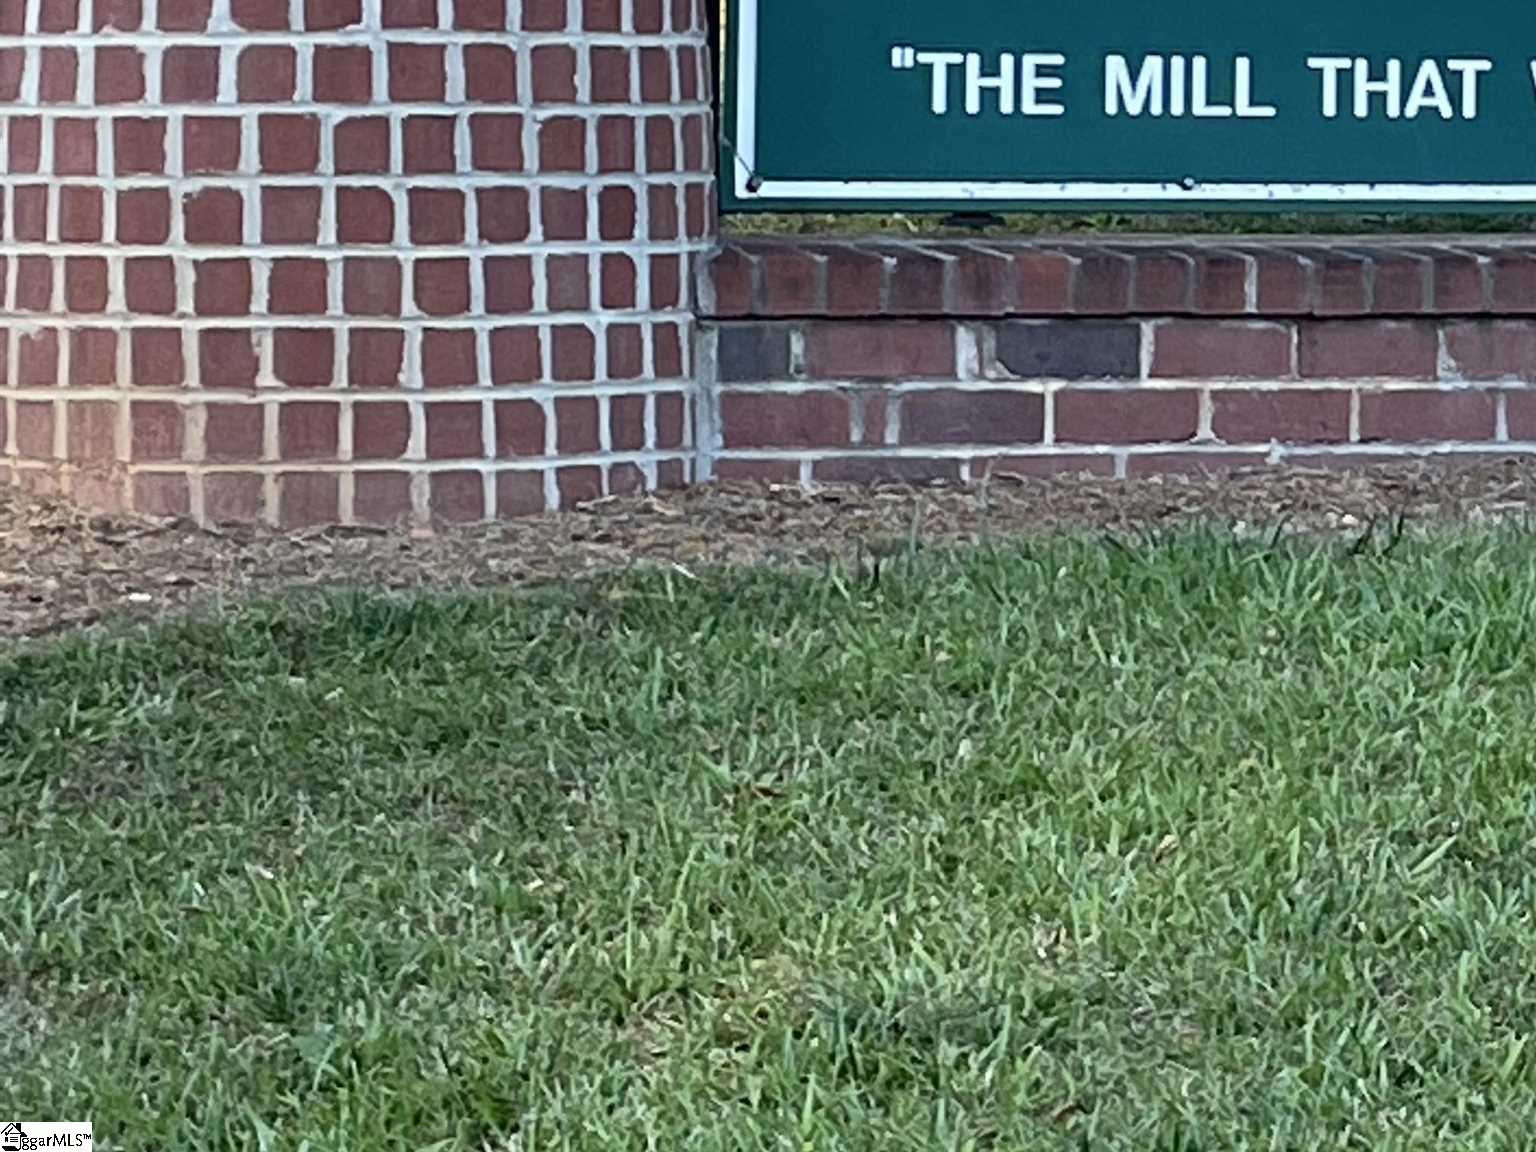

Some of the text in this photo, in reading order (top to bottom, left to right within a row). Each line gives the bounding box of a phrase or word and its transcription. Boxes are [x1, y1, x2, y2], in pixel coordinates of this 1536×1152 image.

[890, 46, 1066, 119] "THE
[1104, 54, 1279, 121] MILL
[1307, 57, 1493, 121] THAT
